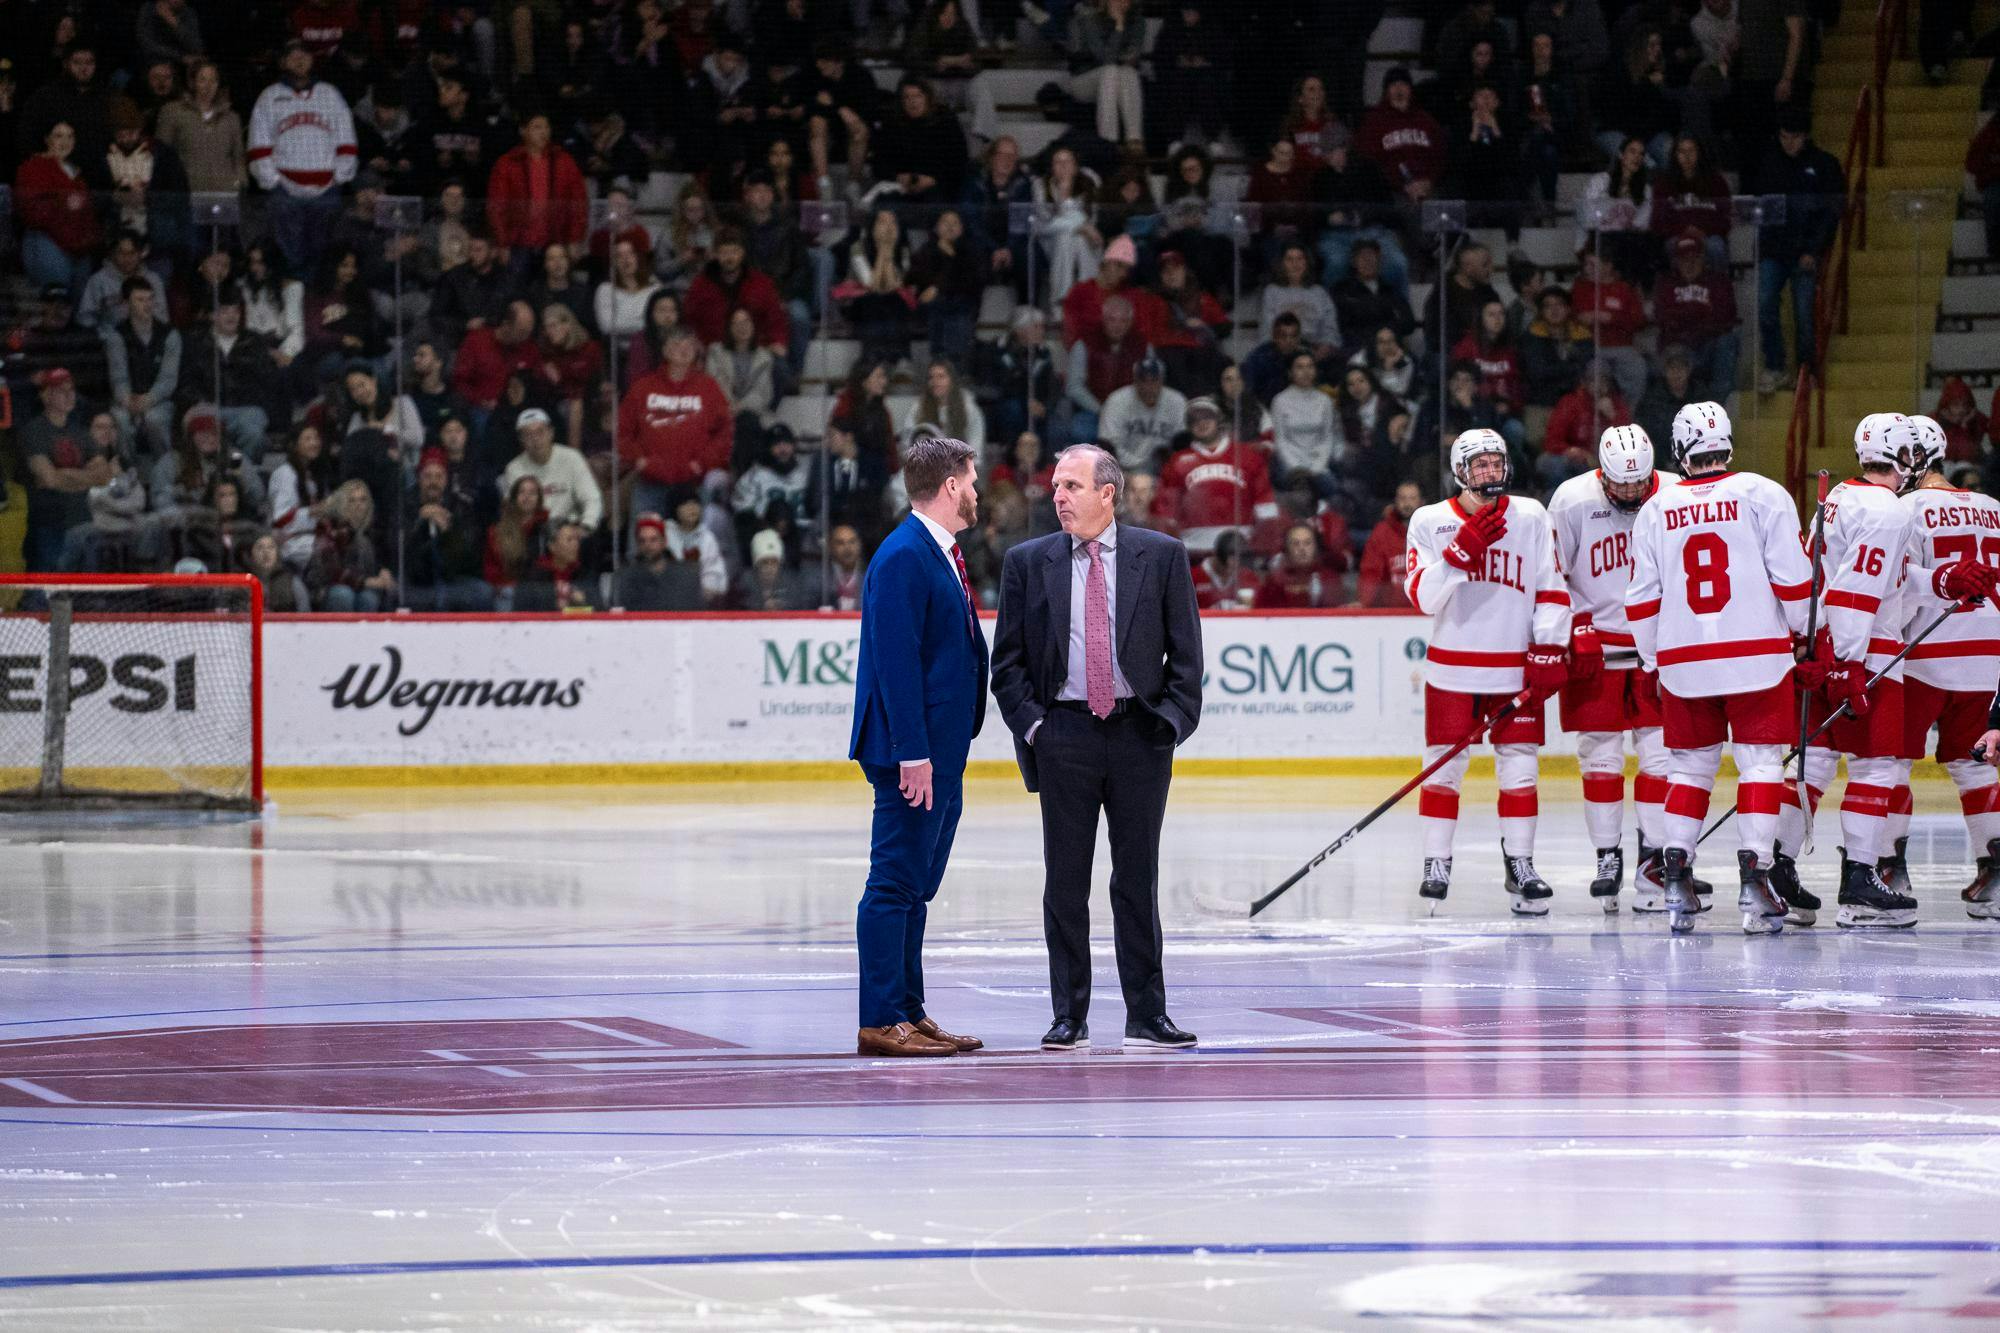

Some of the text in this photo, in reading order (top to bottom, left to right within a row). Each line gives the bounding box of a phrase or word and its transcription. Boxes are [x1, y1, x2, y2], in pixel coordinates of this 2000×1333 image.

[1708, 418, 1715, 429] 8
[1626, 458, 1637, 469] 21
[1664, 500, 1739, 531] DEVLIN
[1924, 507, 2000, 529] CASTAGN
[1590, 529, 1633, 578] COR
[1853, 543, 1886, 577] 16
[1467, 548, 1525, 594] NELL
[1682, 532, 1732, 615] 8
[1219, 643, 1354, 694] SMG
[1527, 652, 1562, 664] CCM
[320, 645, 585, 736] Wegmans
[1303, 702, 1354, 714] GROUP
[1308, 826, 1358, 868] CCM
